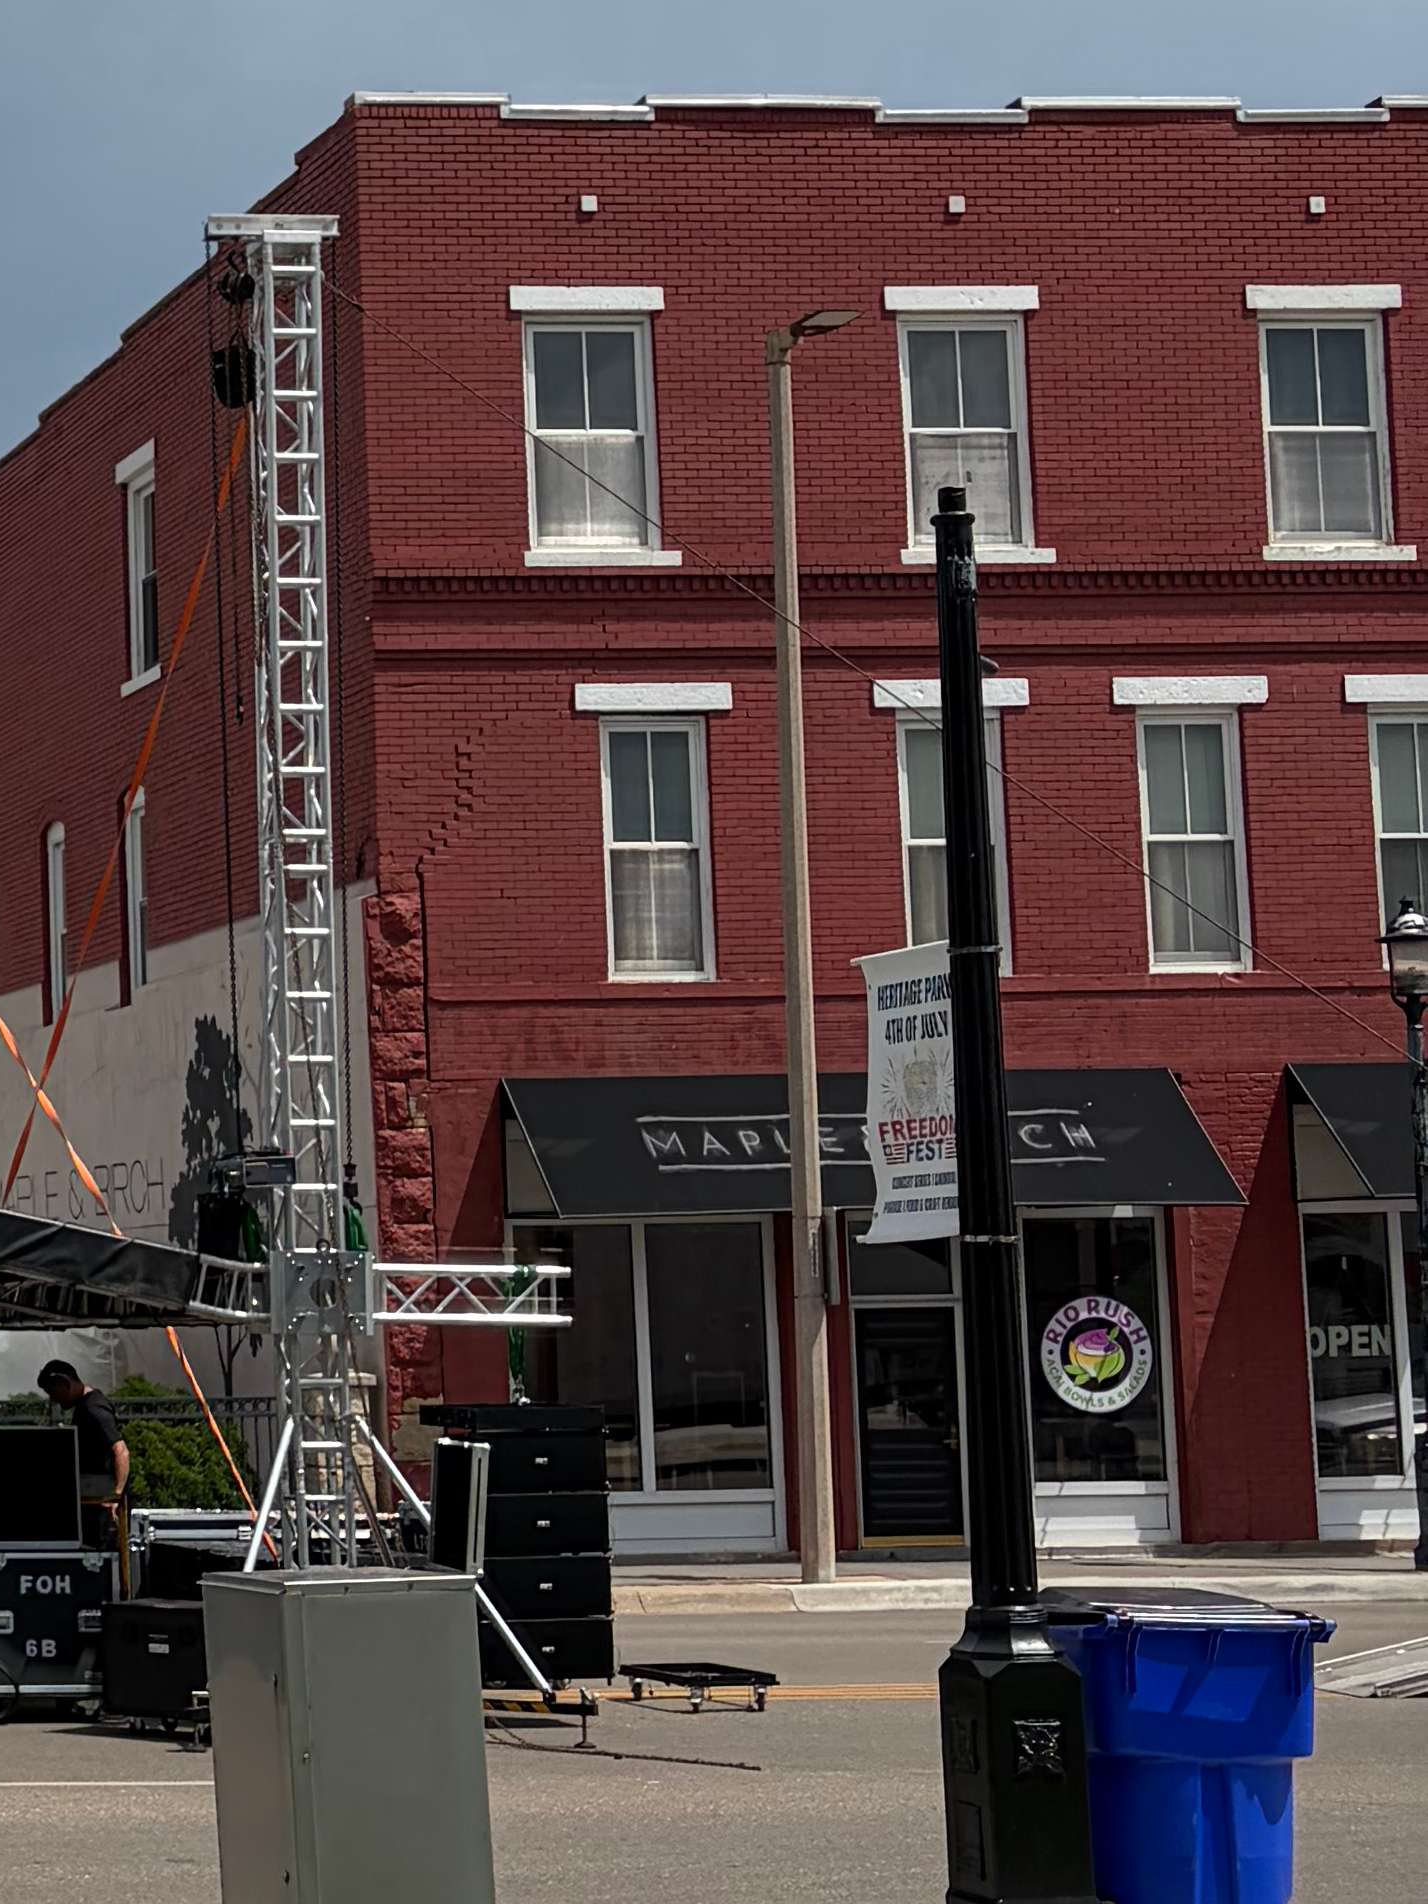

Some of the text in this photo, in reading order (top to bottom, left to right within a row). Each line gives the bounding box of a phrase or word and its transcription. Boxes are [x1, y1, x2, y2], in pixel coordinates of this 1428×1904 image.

[878, 978, 923, 1011] HERITAGE
[885, 1010, 948, 1045] 4TH OF JULY
[641, 1126, 845, 1158] MAPLE
[906, 1138, 943, 1163] FEST
[1046, 1298, 1148, 1345] RIO RUSH
[1308, 1324, 1392, 1358] OPEN
[20, 1575, 71, 1595] FOH
[25, 1639, 57, 1657] 6B
